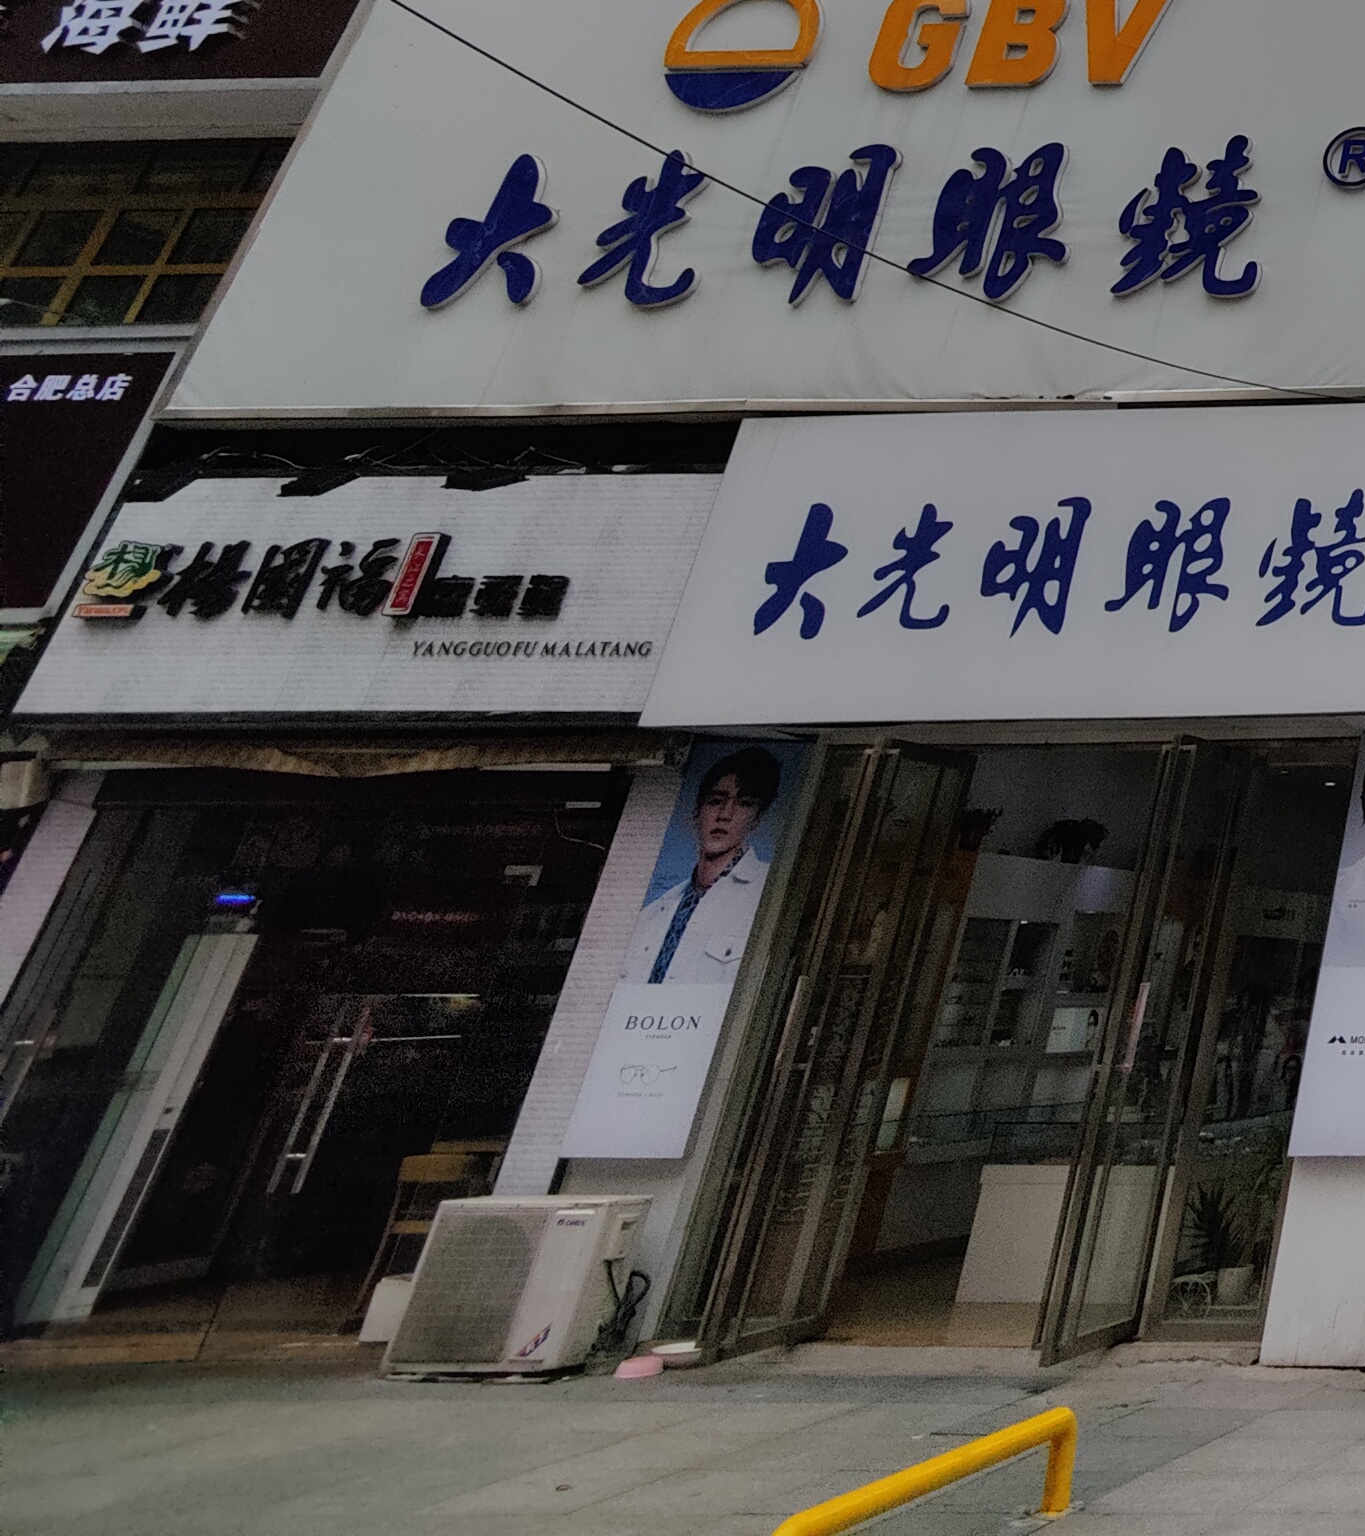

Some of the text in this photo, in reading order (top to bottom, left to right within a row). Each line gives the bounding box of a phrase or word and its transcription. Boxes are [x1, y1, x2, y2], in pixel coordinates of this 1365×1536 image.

[7, 374, 133, 402] 合肥总店
[624, 1015, 702, 1031] BOLON
